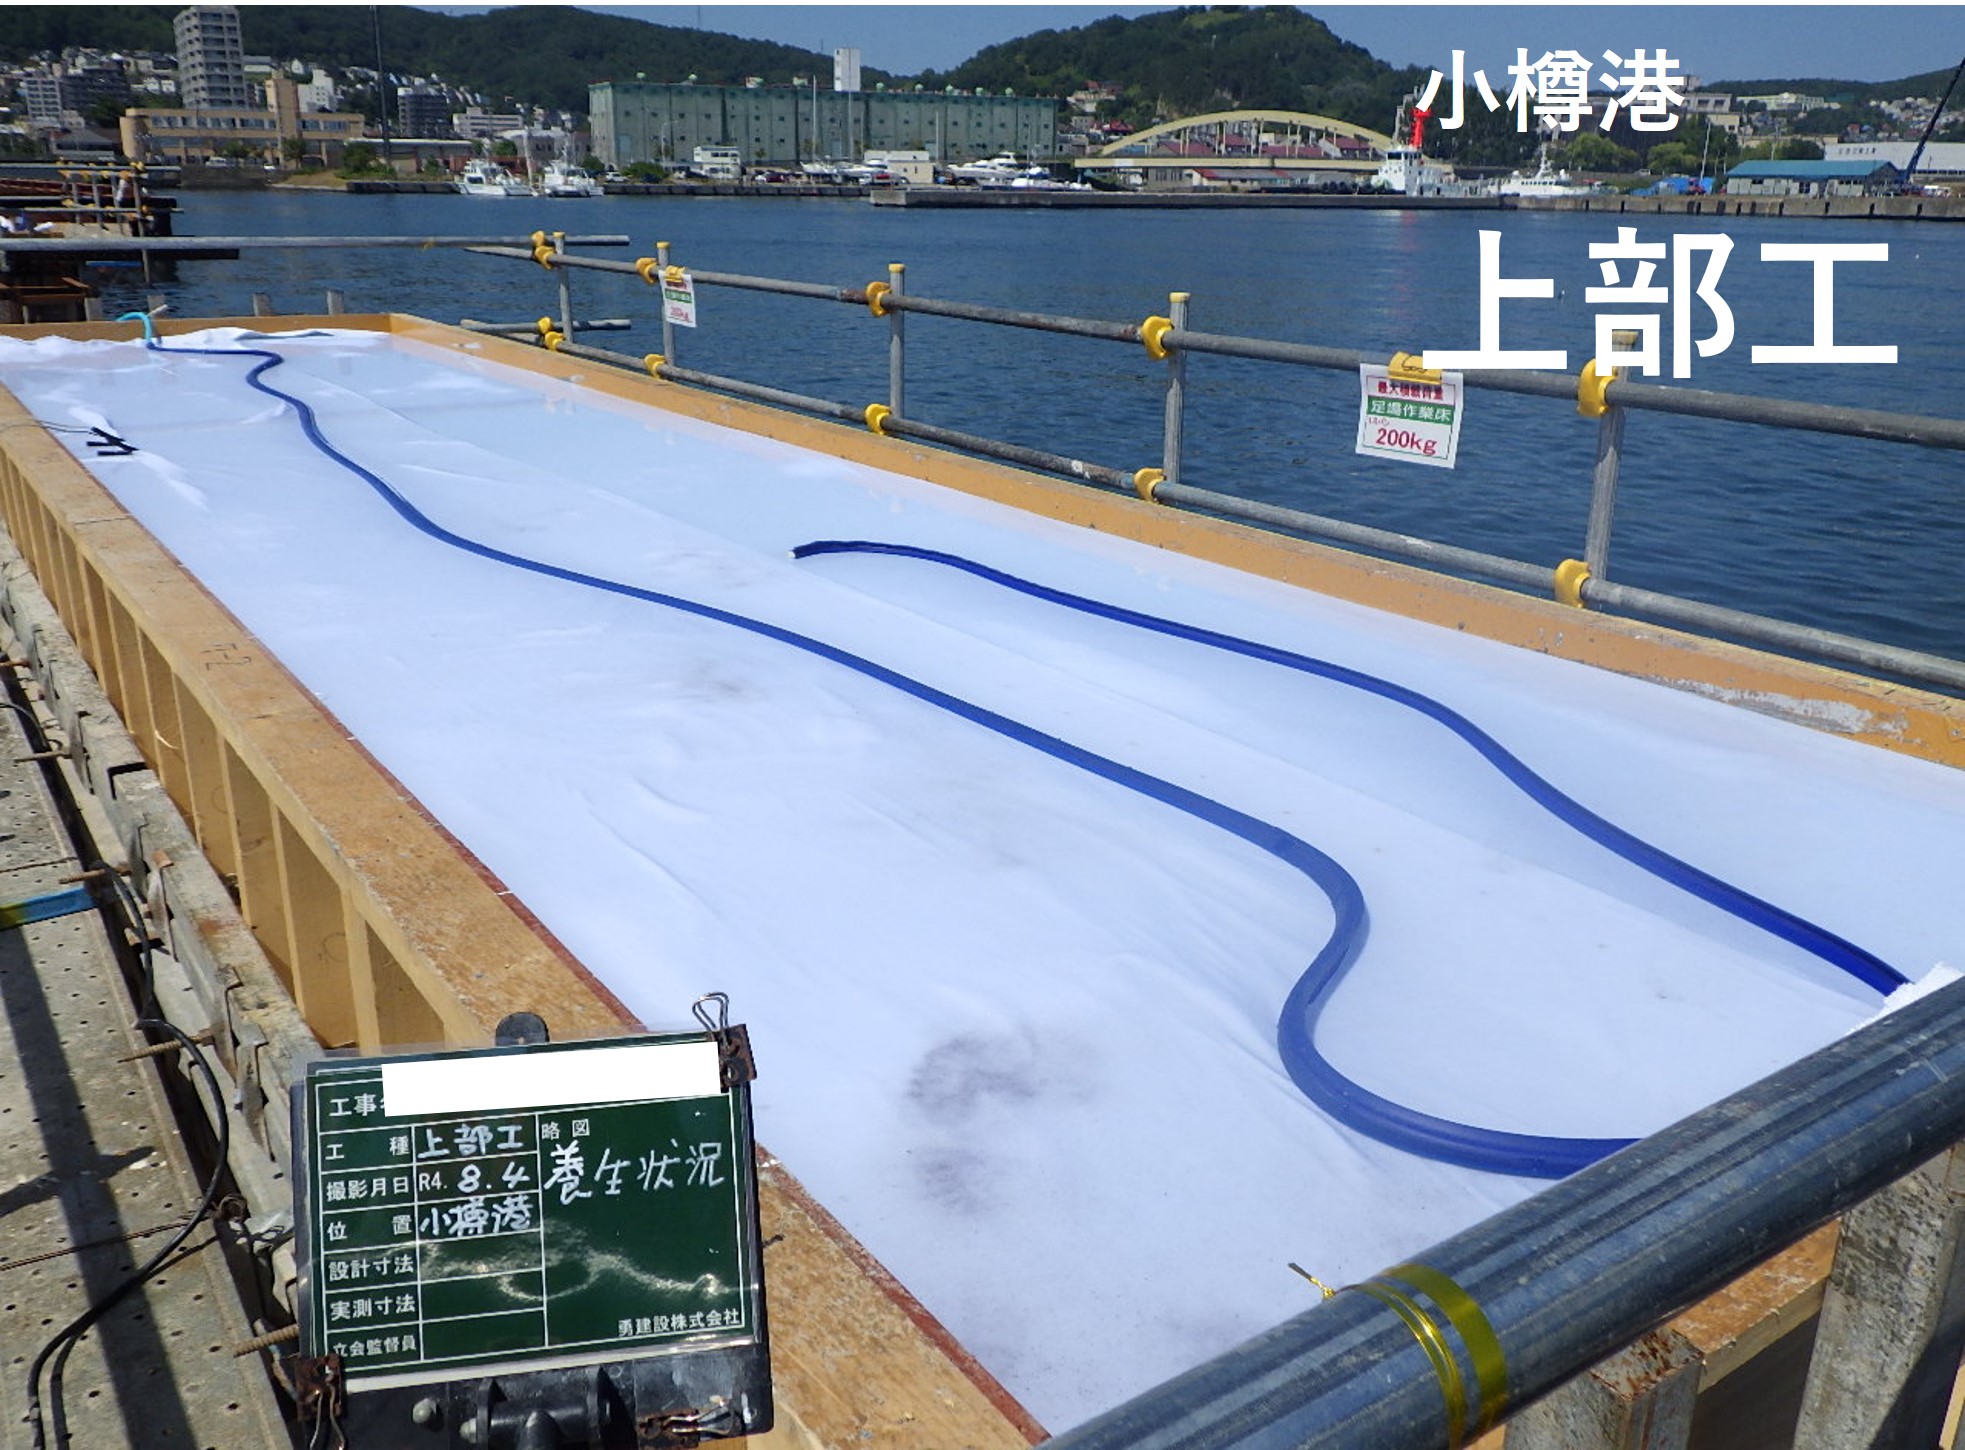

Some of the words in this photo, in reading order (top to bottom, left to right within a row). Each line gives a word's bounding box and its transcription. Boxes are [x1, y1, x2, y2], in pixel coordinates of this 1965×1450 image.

[1376, 427, 1437, 456] 200kg
[329, 1093, 385, 1116] 工事
[417, 1123, 524, 1159] 上部工
[541, 1118, 590, 1140] 略図
[543, 1138, 725, 1205] 養生状況
[326, 1176, 409, 1202] 撮影月日
[420, 1194, 533, 1237] 小樽港
[328, 1254, 414, 1282] 設計寸法
[330, 1293, 416, 1321] 実測寸法
[618, 1308, 741, 1336] 勇建設株式会社
[332, 1334, 417, 1358] 立会監督員
